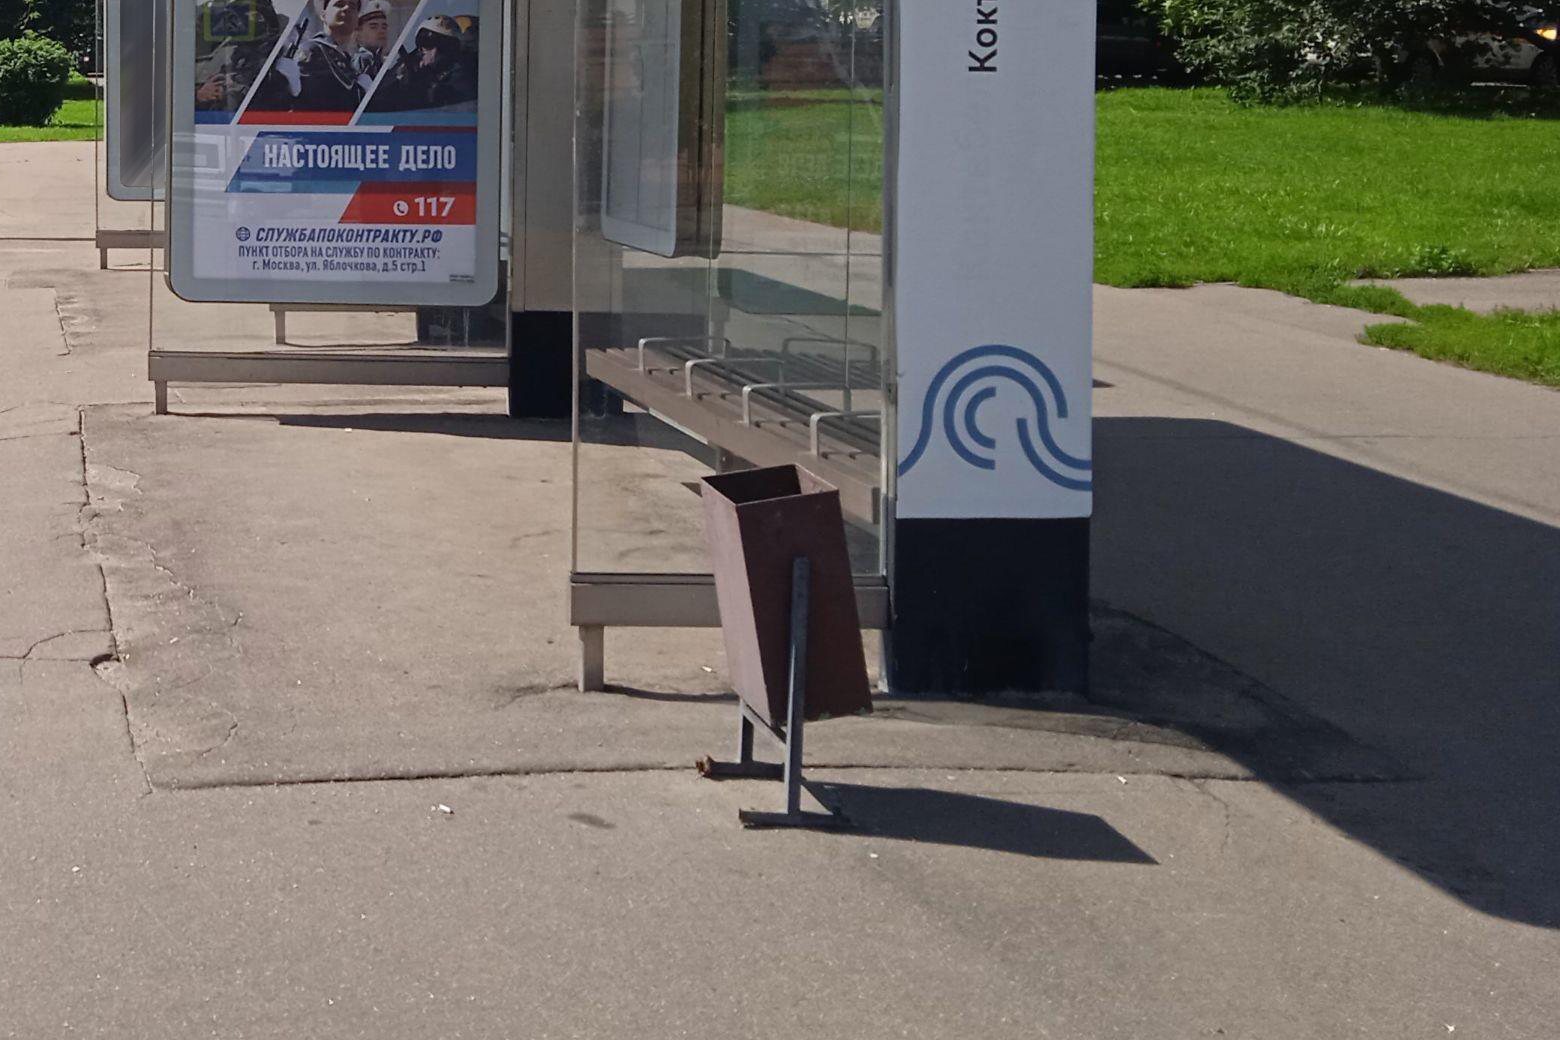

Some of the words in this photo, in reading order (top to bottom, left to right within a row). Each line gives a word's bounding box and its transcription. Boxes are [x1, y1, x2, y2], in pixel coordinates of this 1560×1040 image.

[264, 144, 390, 173] НАСТОЯЩЕЕ
[398, 145, 457, 172] ДЕЛО
[414, 196, 456, 218] 117
[255, 227, 443, 244] СЛУЖБАПОКОНТРАКТУ.РФ
[238, 245, 270, 258] ПУНКТ
[271, 246, 309, 258] ОТБОРА
[311, 246, 323, 258] НА
[325, 246, 364, 259] СЛУЖБУ
[367, 247, 380, 259] ПО
[382, 247, 441, 260] КОНТРАКТУ:
[252, 260, 260, 271] г.
[262, 259, 304, 272] Москва,
[305, 261, 321, 273] ул.
[322, 259, 380, 273] Яблочкова,
